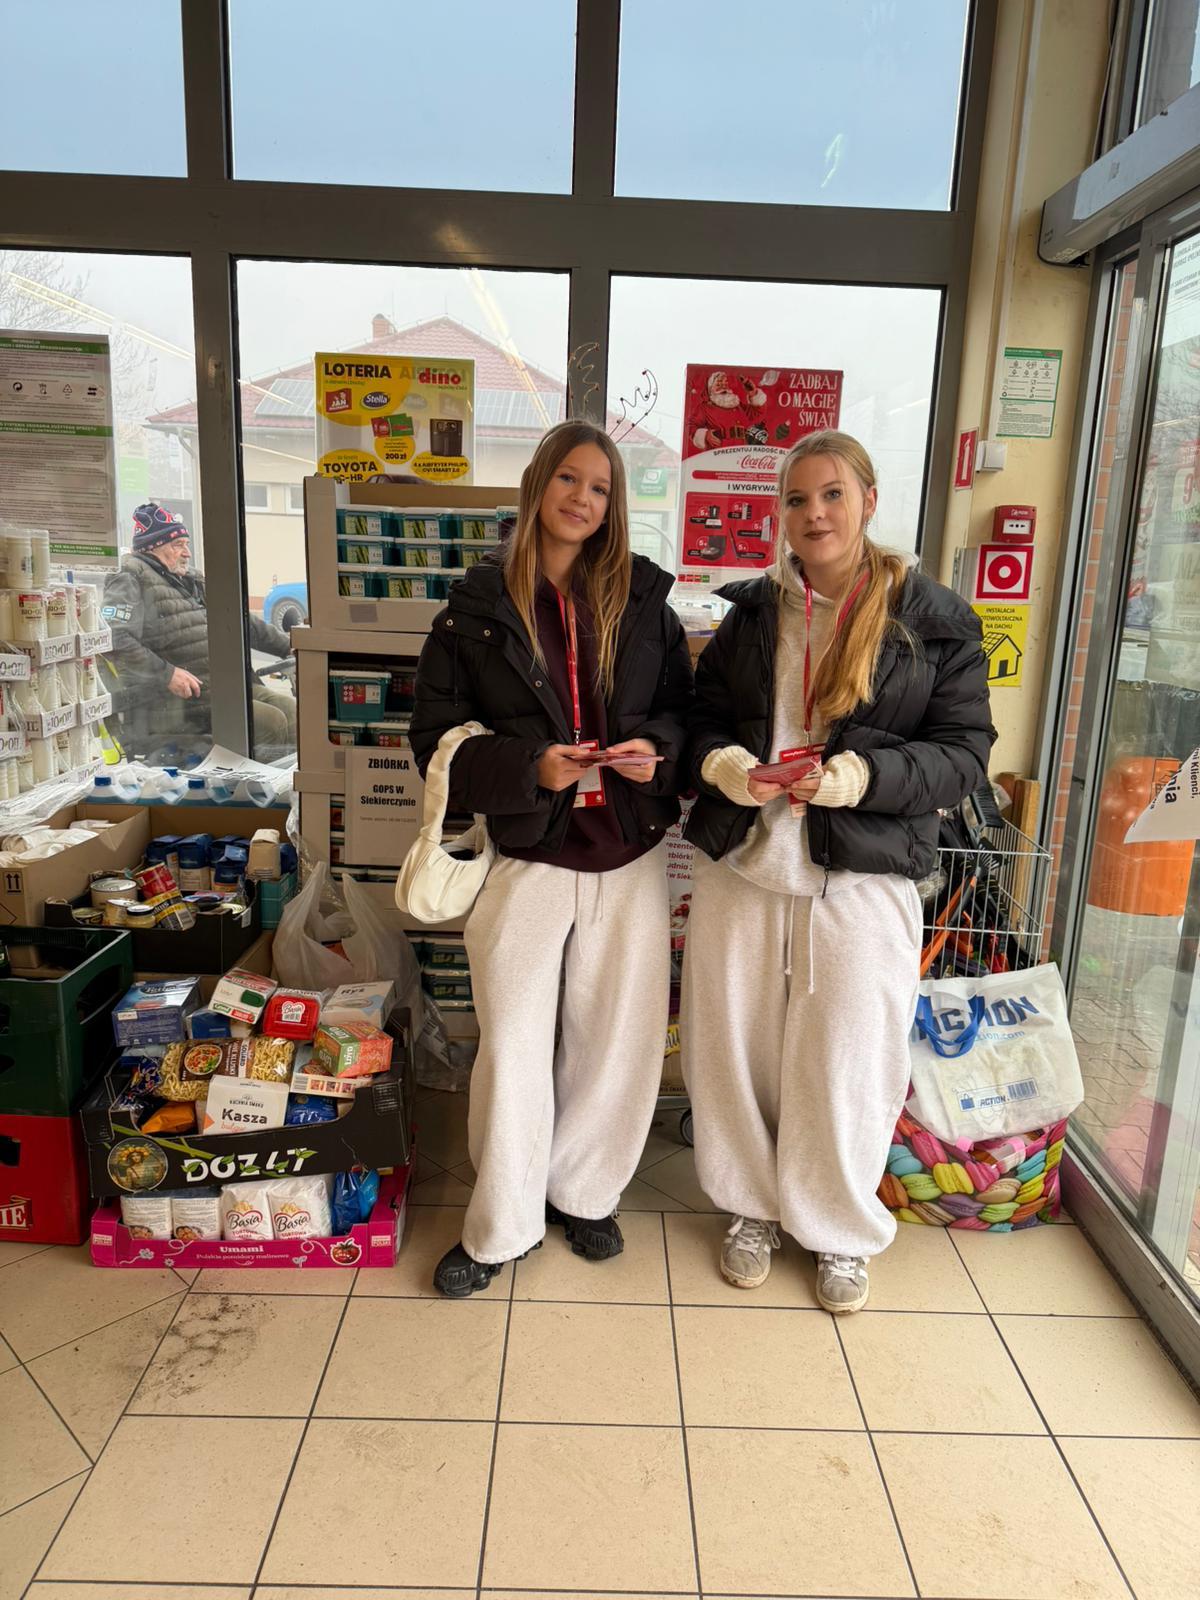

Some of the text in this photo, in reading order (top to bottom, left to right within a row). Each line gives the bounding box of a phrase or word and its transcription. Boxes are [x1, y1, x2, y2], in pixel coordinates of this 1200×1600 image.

[324, 362, 392, 379] LOTERIA
[418, 367, 462, 385] dino
[789, 373, 838, 390] ZADBAJ
[366, 394, 389, 404] Stella
[778, 391, 791, 408] O
[713, 447, 752, 456] SPREZENTUJ
[323, 461, 378, 473] TOYOTA
[732, 484, 778, 492] WYGRYWA
[368, 757, 410, 770] ZBIÓRKA
[372, 784, 405, 794] GOPS W
[360, 795, 417, 807] Siekierczynie
[221, 1108, 268, 1125] Kasza
[229, 1214, 261, 1230] Basia
[275, 1214, 309, 1233] Basia
[219, 1245, 265, 1253] Umami
